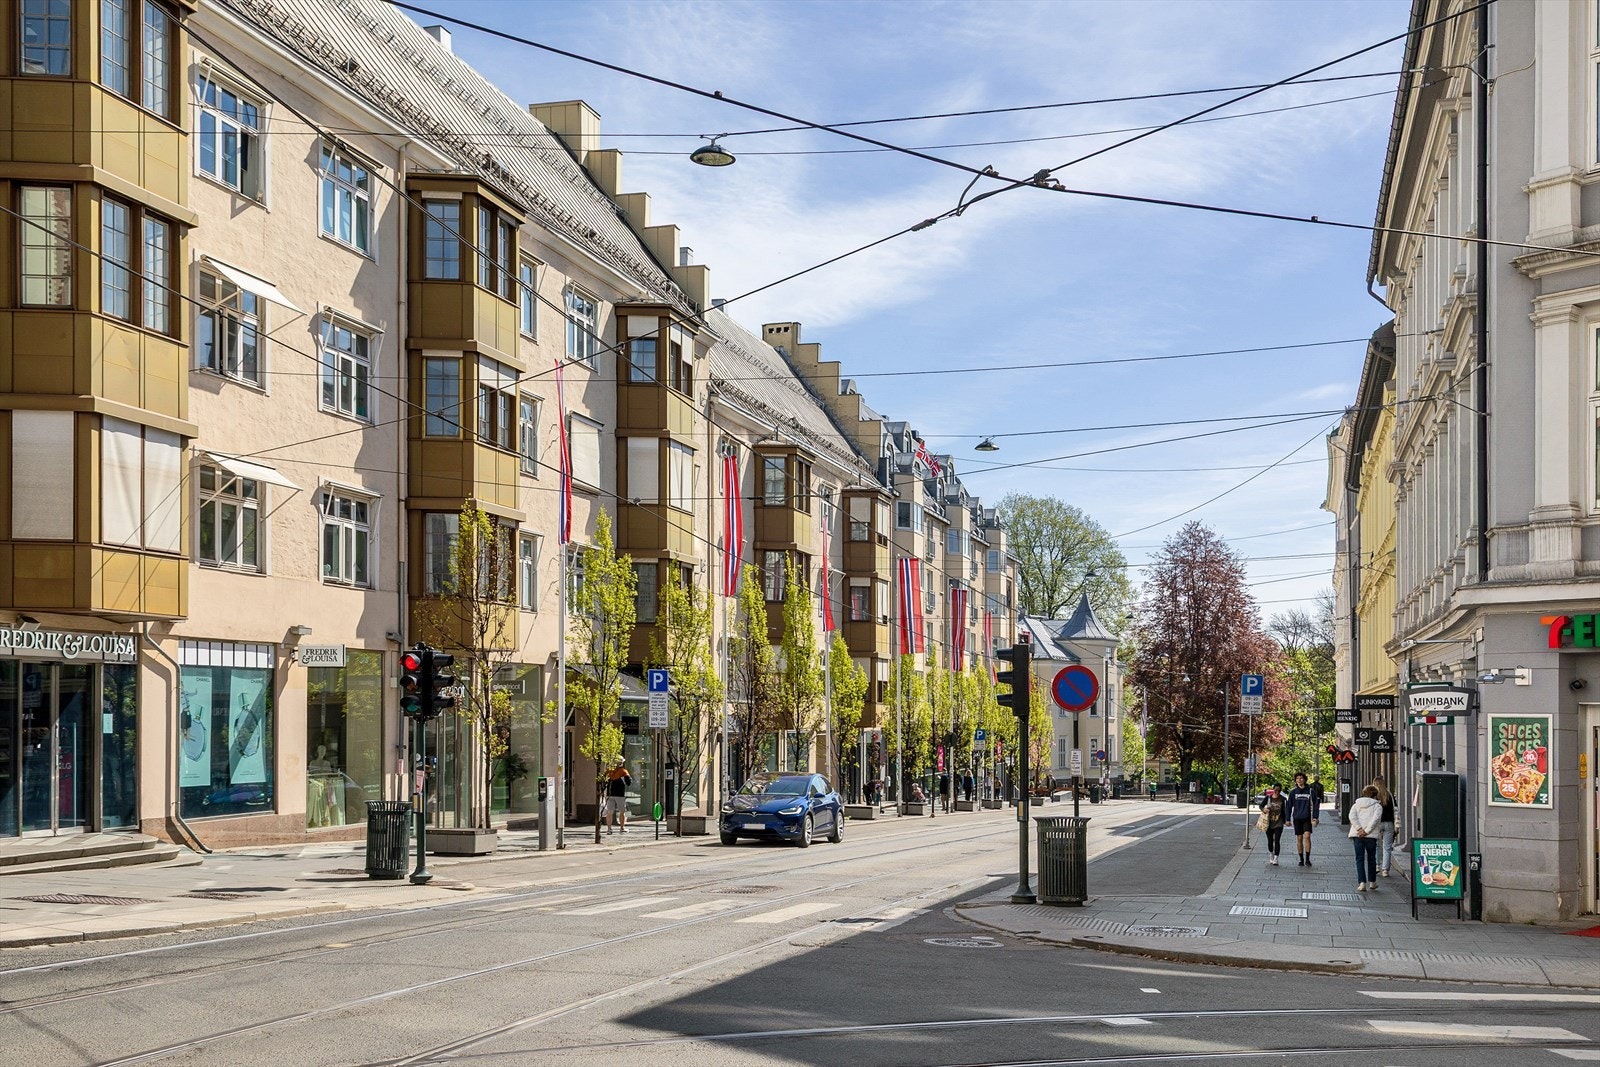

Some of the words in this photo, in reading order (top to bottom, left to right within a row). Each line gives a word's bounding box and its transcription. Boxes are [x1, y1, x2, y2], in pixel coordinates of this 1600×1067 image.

[653, 672, 664, 689] P
[1246, 676, 1258, 693] P
[1414, 697, 1464, 705] MINIBANK
[1498, 723, 1542, 739] SLICES
